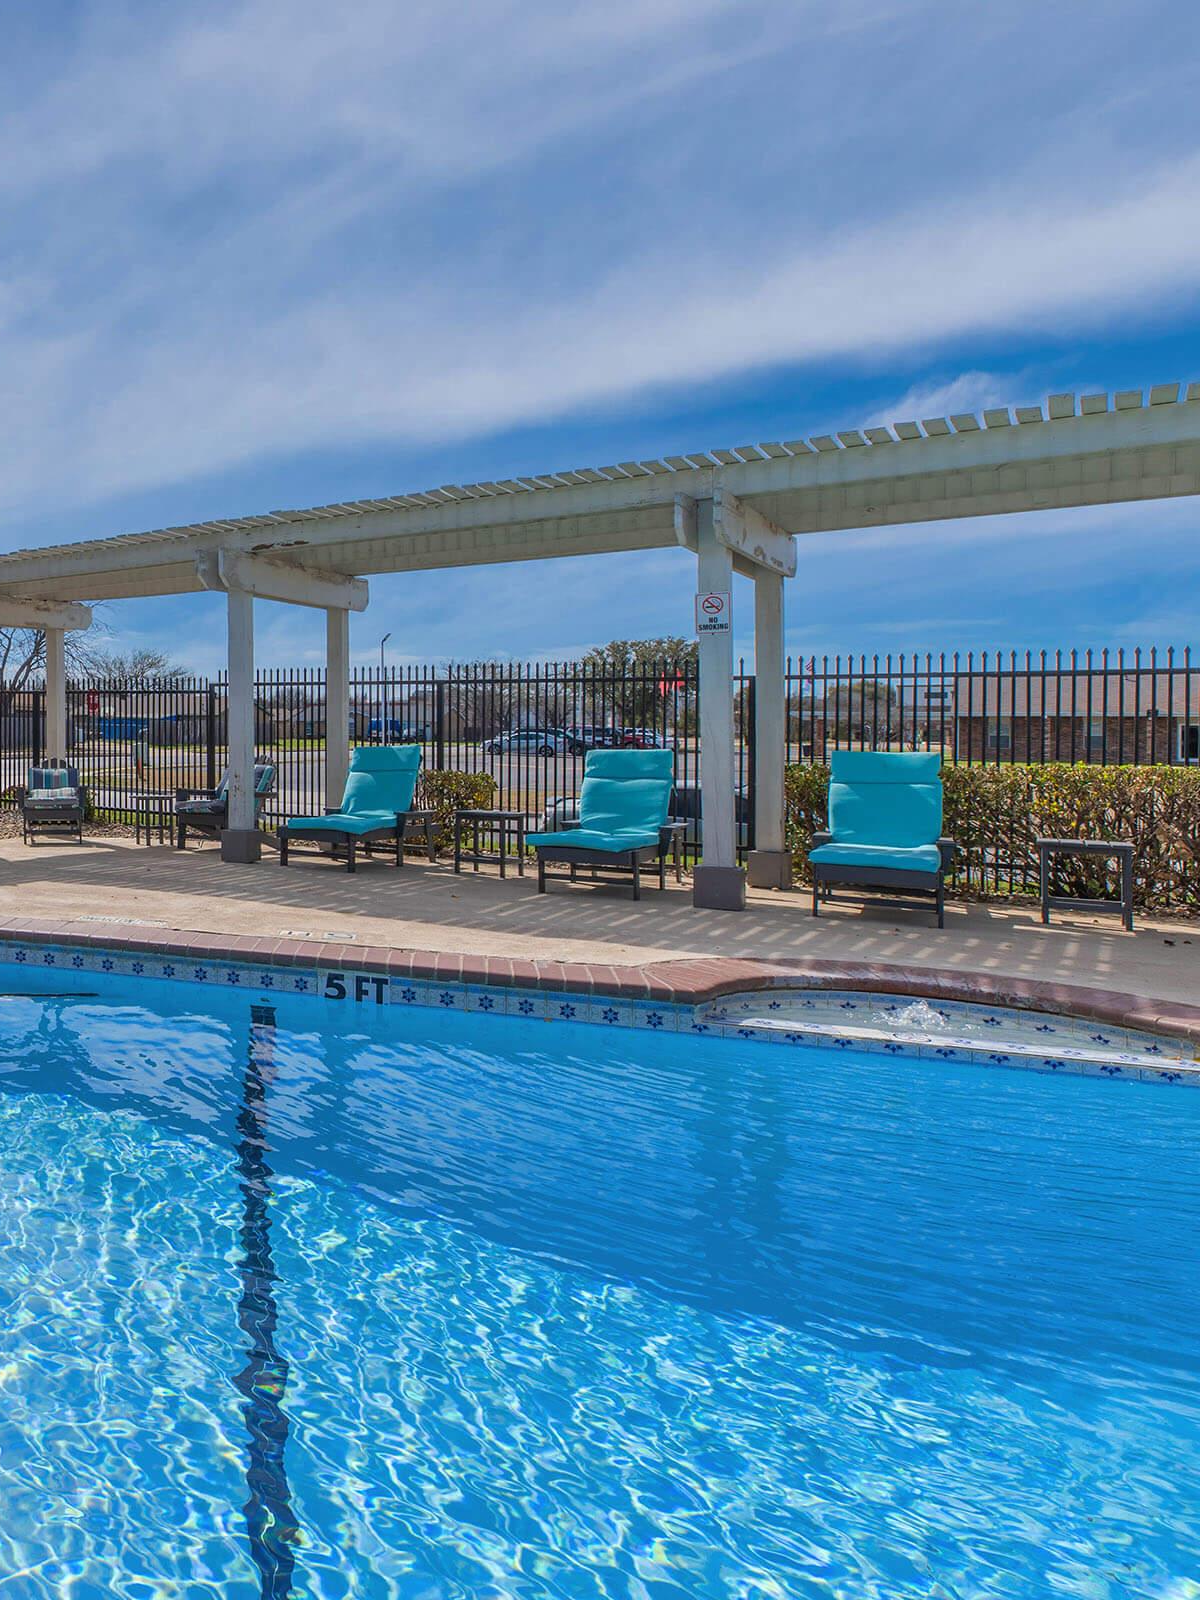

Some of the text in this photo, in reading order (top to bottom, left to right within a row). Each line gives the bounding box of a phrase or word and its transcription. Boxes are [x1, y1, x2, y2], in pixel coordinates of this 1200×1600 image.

[698, 623, 729, 631] SMOKING
[324, 973, 389, 1005] 5 FT
